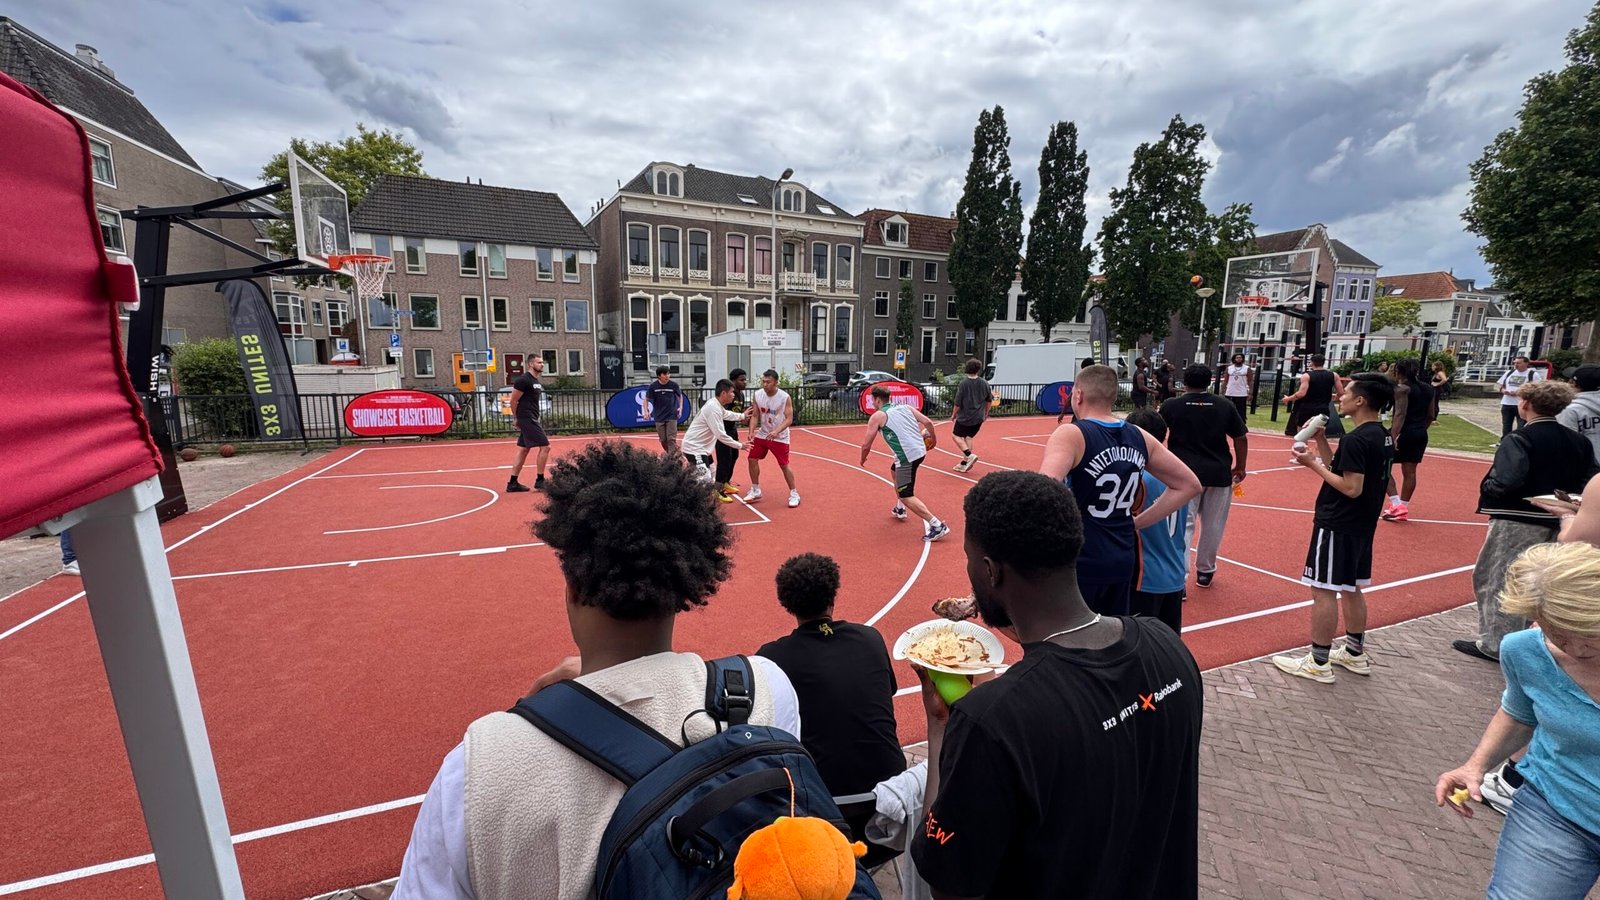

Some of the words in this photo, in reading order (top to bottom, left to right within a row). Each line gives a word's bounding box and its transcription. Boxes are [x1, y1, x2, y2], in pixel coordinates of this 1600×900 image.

[149, 355, 160, 391] WISH
[352, 408, 398, 428] SHOWCASE
[399, 407, 446, 426] BASKETBALL
[1087, 472, 1139, 519] 34
[1102, 716, 1117, 731] 3X3
